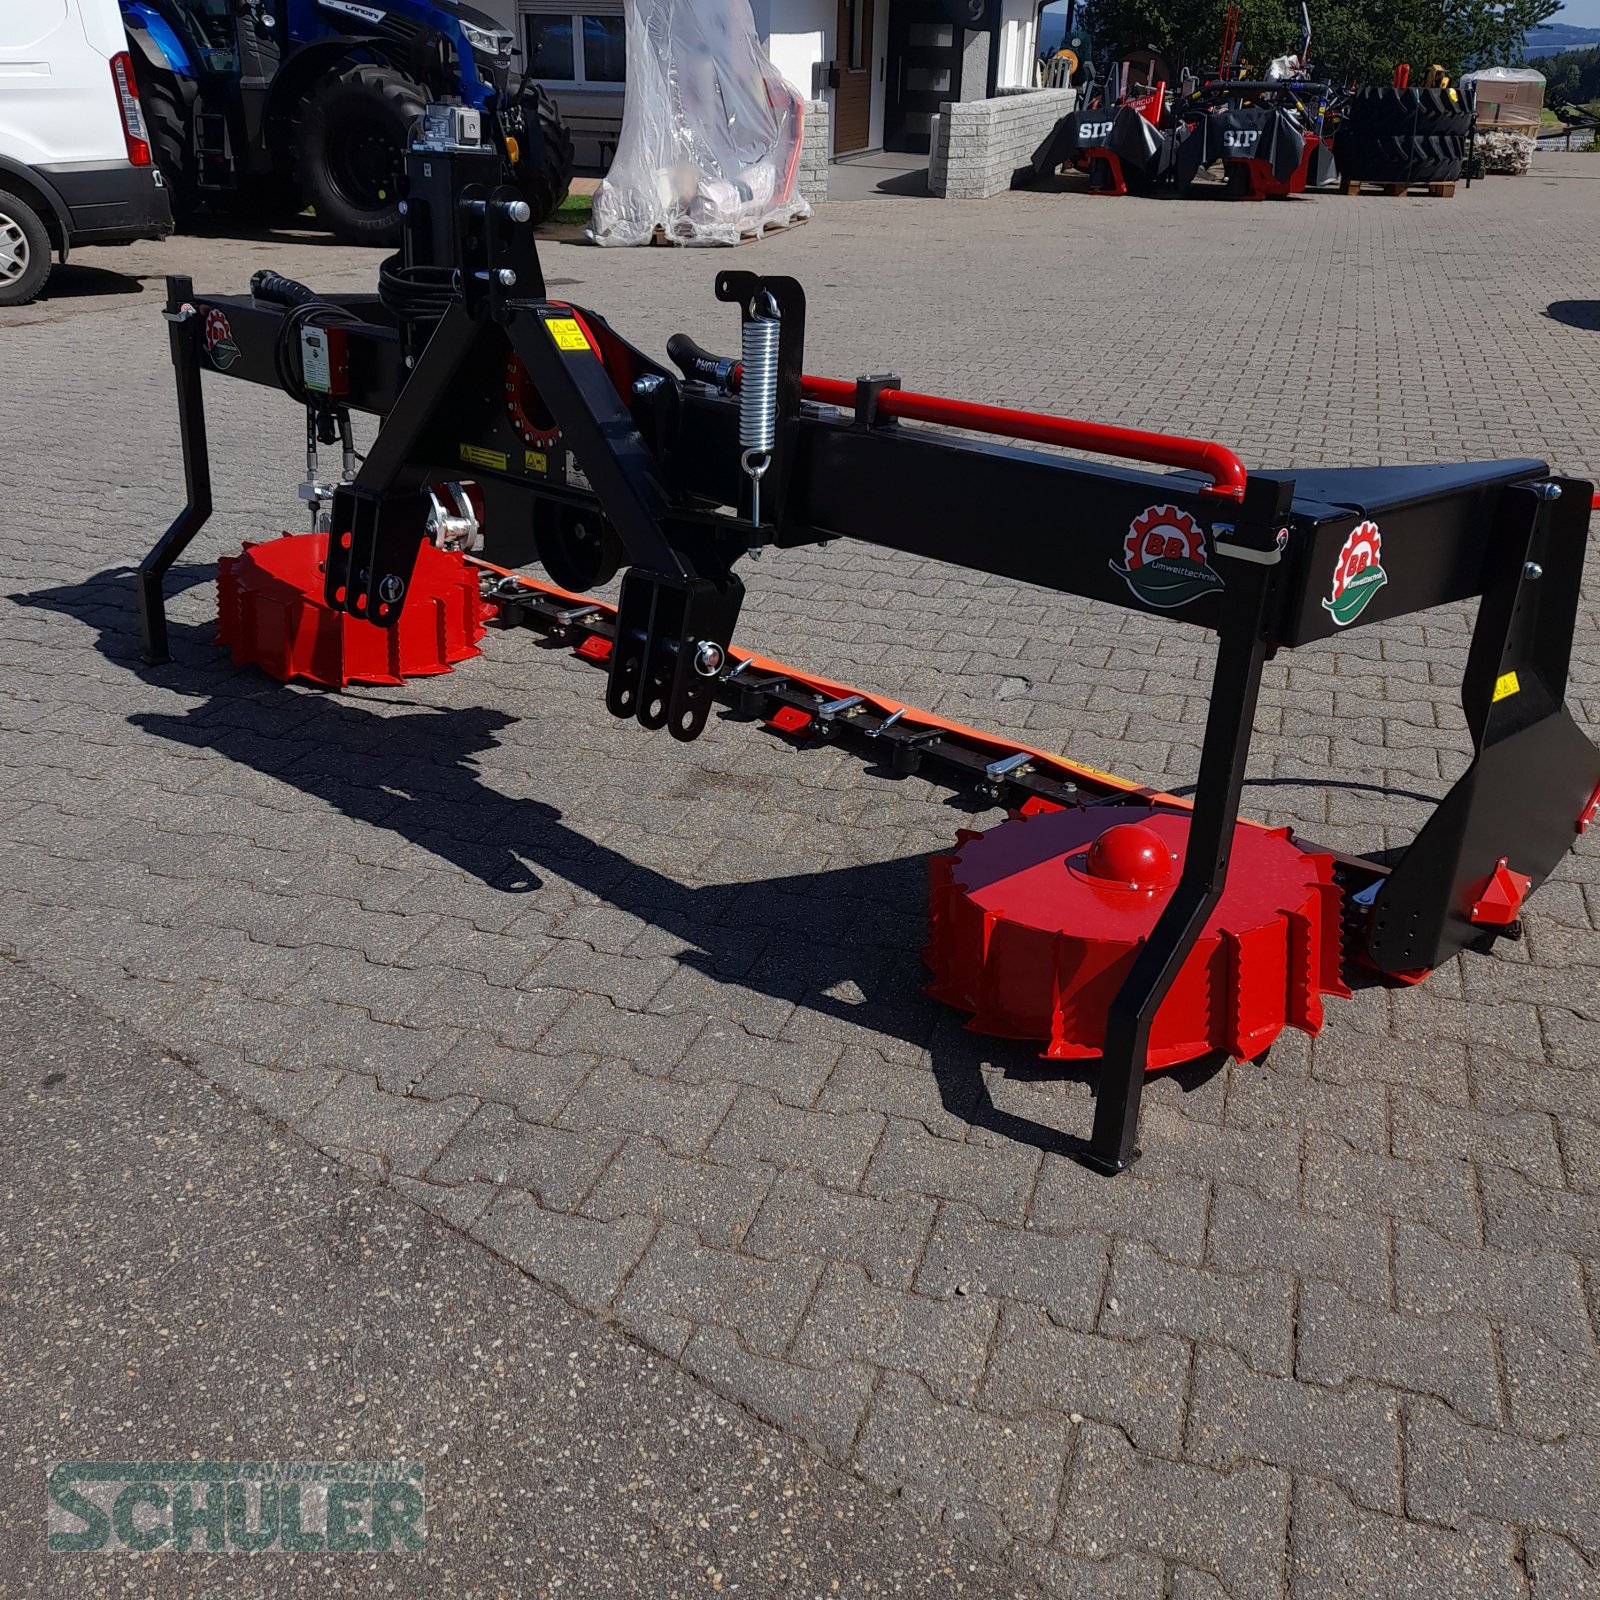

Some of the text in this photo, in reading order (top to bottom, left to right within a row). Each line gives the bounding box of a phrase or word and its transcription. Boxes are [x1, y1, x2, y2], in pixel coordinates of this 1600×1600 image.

[345, 4, 379, 20] LANDINI
[1079, 121, 1113, 139] SIP
[1223, 130, 1258, 147] SIP
[1145, 532, 1184, 559] BB
[1151, 561, 1217, 583] Umwelttechnik
[1346, 551, 1369, 577] BB
